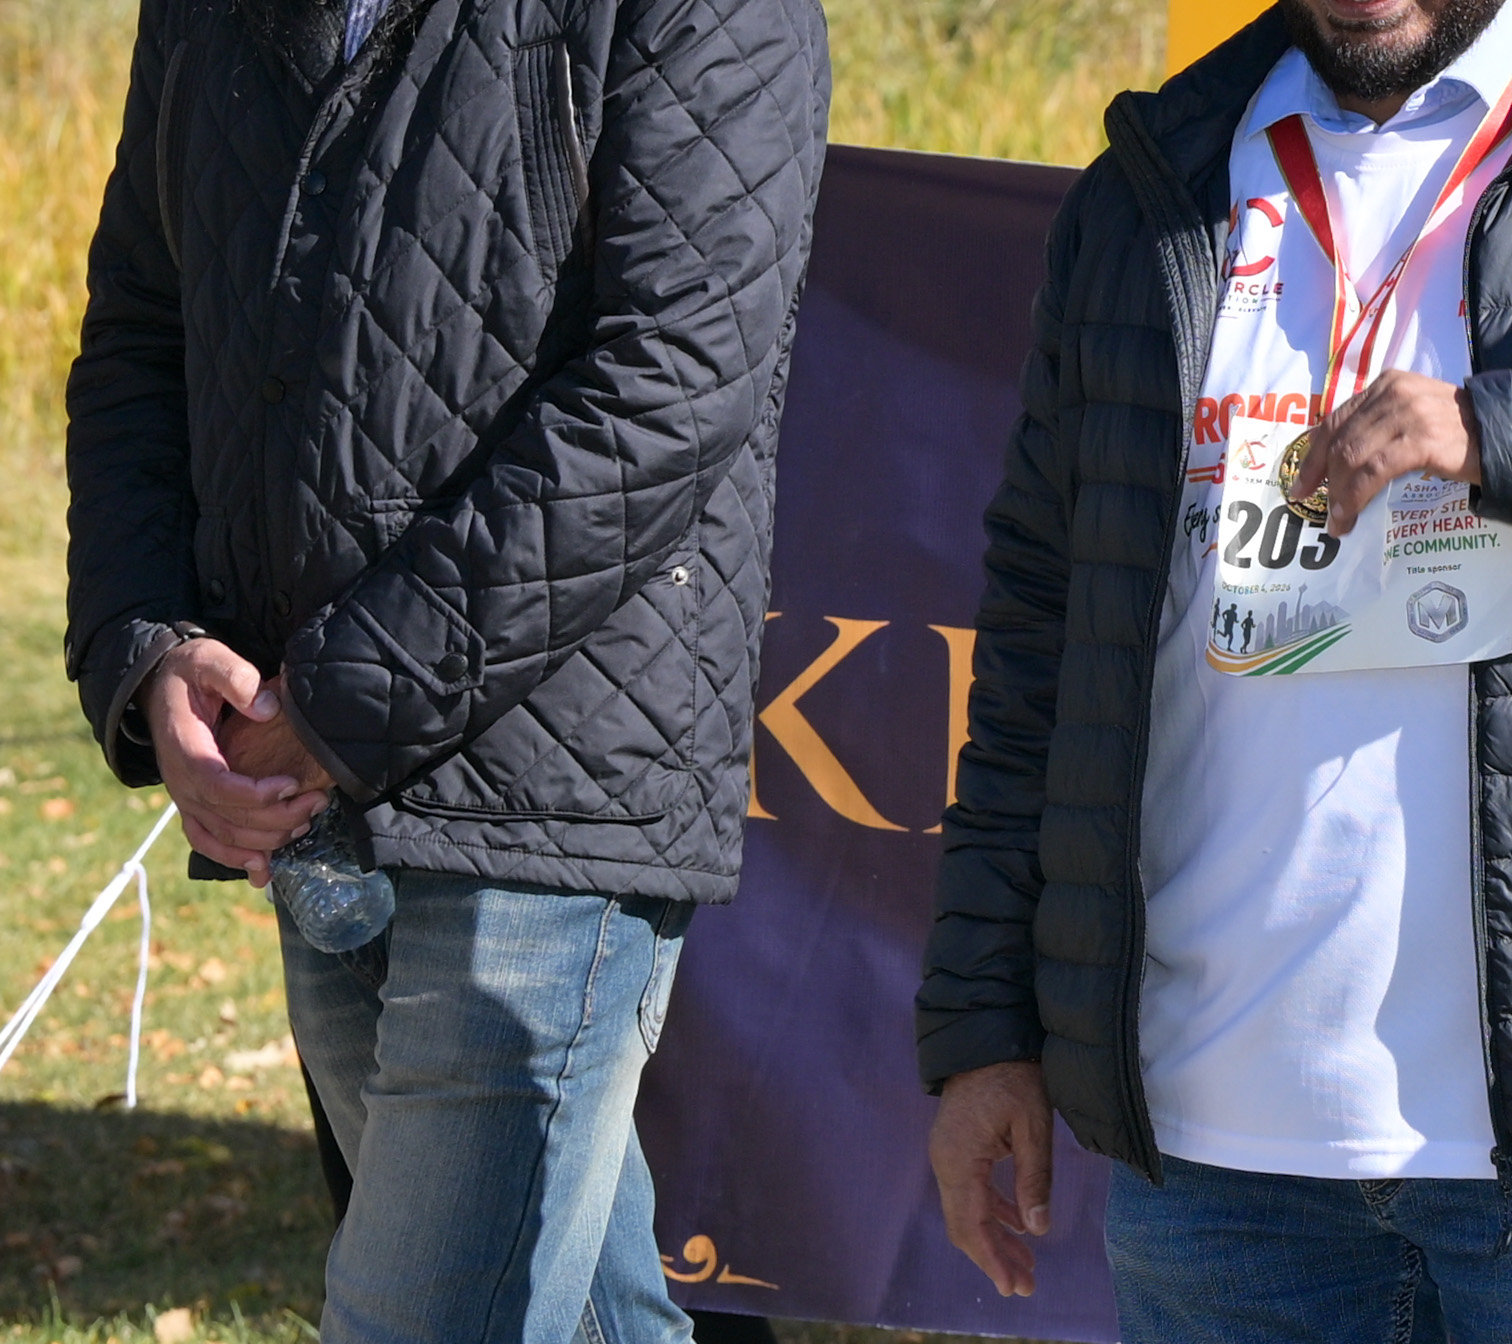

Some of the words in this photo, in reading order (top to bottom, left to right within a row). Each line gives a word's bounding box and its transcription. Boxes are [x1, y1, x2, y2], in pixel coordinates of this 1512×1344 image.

[1391, 507, 1437, 524] EVERY
[1441, 497, 1468, 514] STE
[1386, 521, 1429, 544] EVERY
[1432, 515, 1488, 533] HEART.
[1403, 533, 1501, 556] COMMUNITY.
[1407, 566, 1426, 575] Title
[1428, 562, 1462, 574] sponsor
